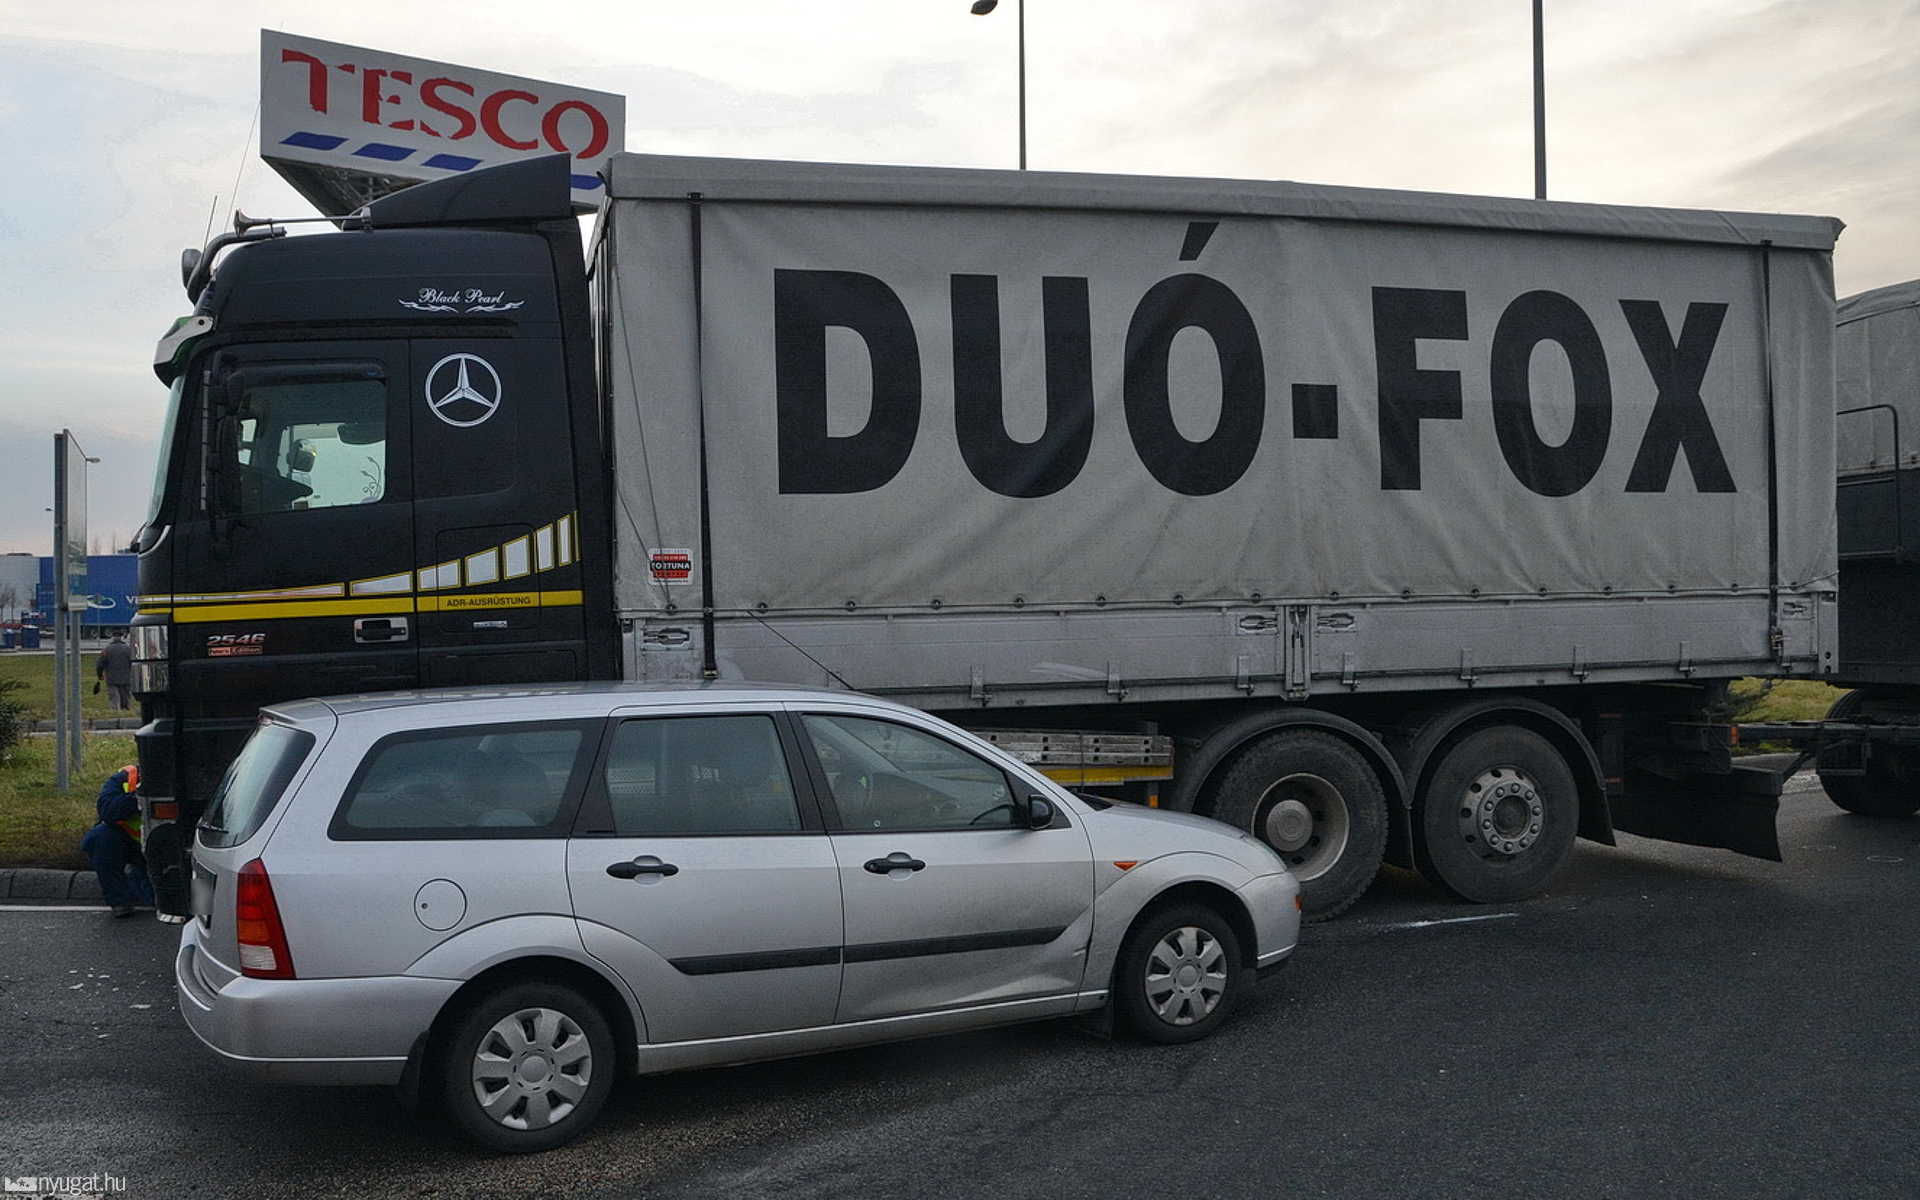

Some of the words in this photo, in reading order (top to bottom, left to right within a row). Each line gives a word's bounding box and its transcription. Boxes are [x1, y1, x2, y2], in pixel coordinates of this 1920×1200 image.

[282, 48, 609, 159] TESCO
[418, 287, 460, 303] Black
[464, 287, 505, 303] Pearl
[774, 221, 1738, 499] DUÓ-FOX
